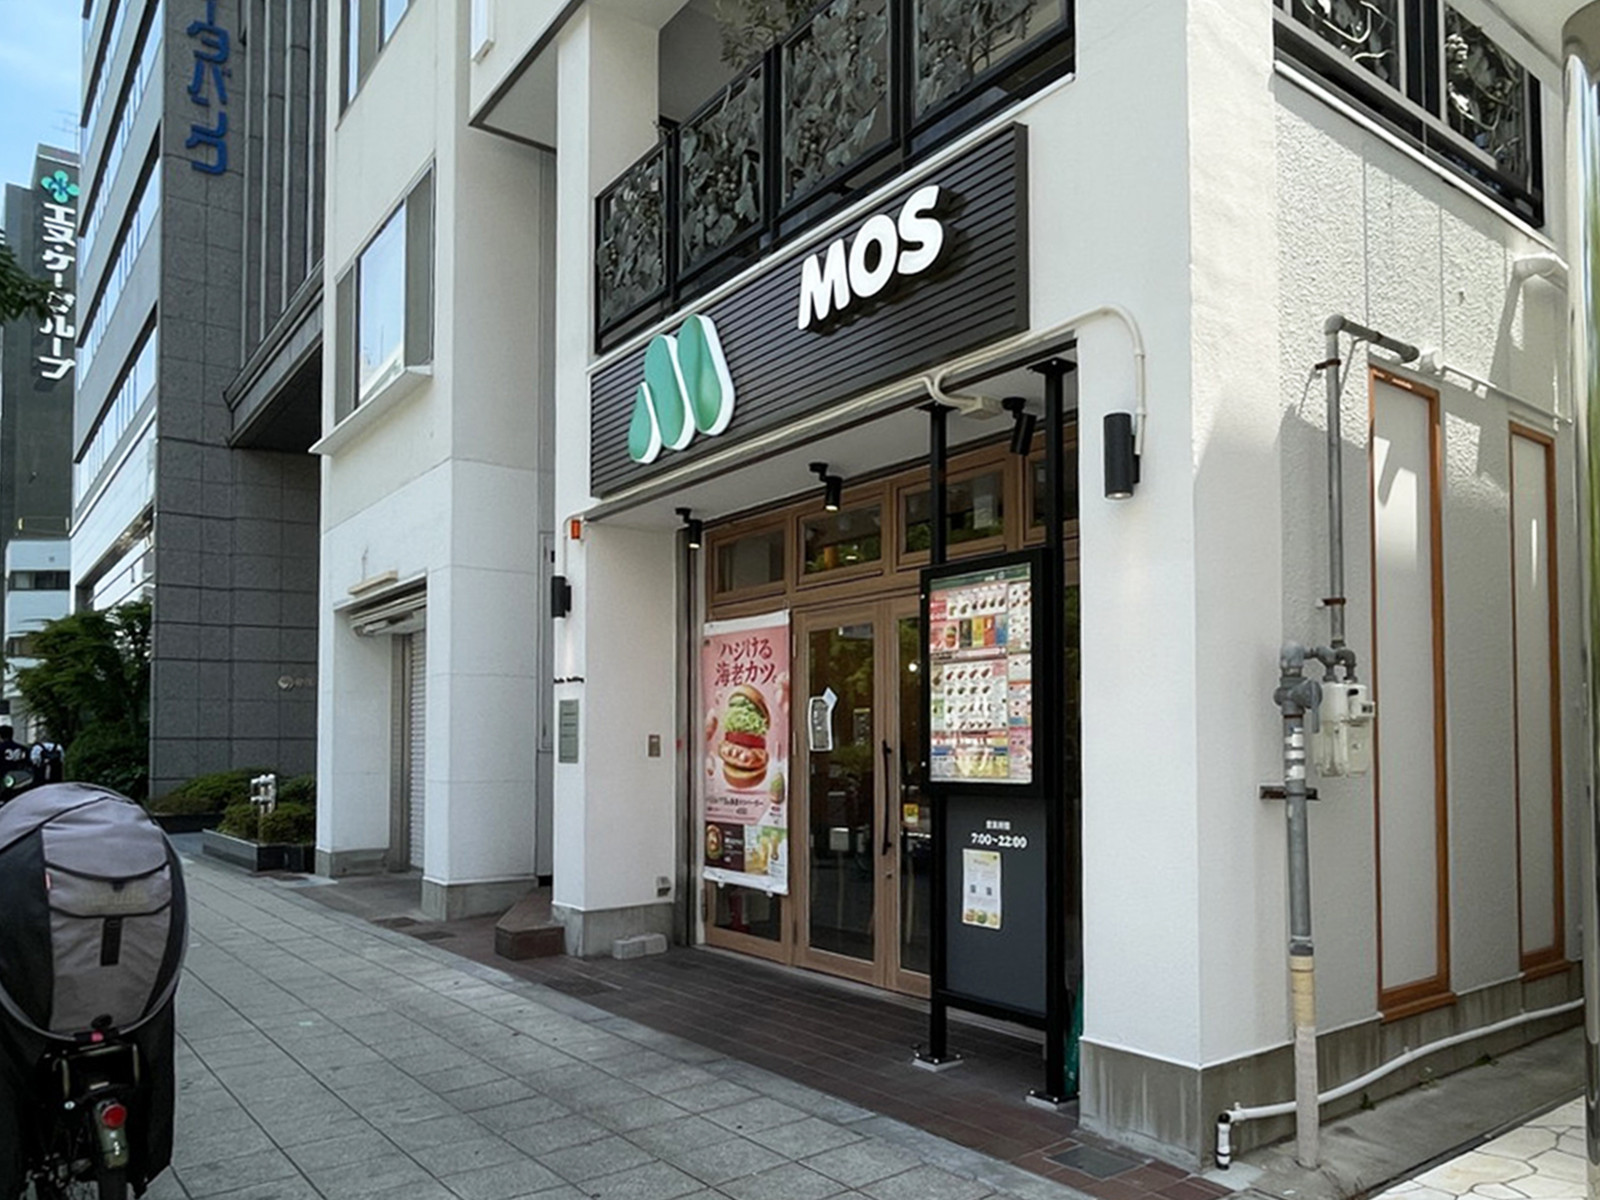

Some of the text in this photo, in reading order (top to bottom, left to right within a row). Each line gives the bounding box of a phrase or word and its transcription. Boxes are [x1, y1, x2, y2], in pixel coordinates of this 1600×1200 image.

[798, 185, 943, 330] MOS
[720, 637, 773, 660] ハジける
